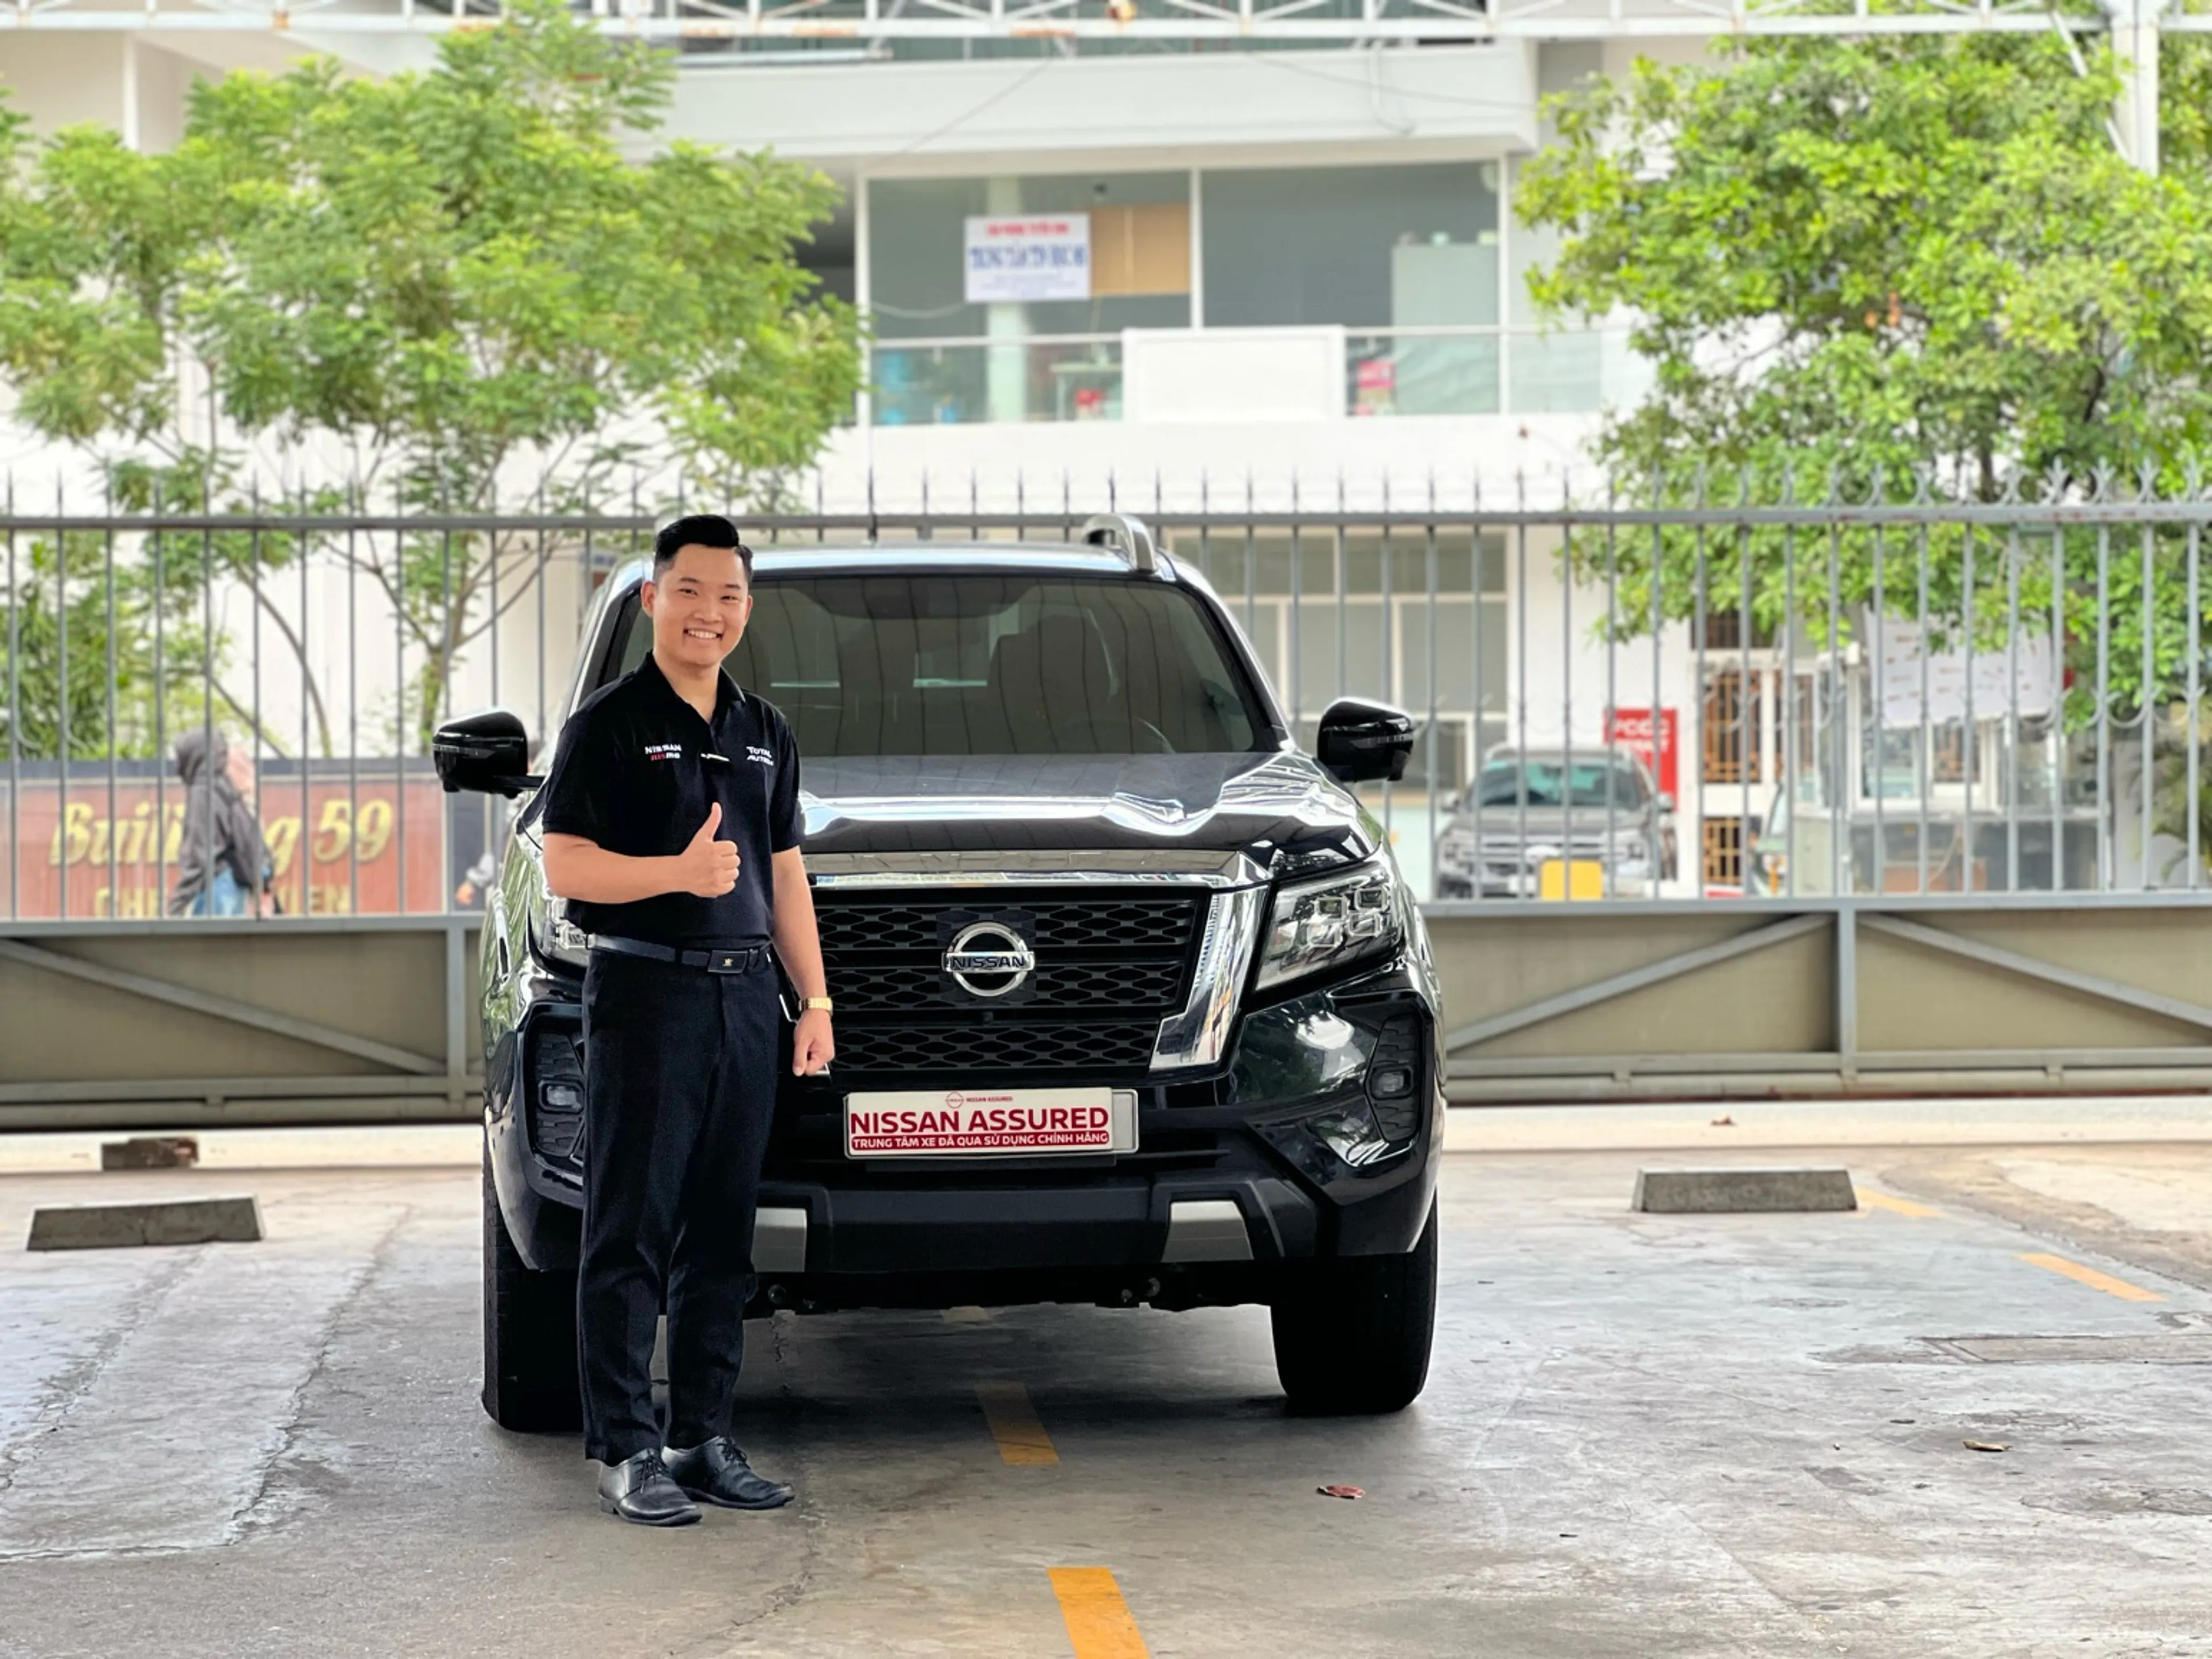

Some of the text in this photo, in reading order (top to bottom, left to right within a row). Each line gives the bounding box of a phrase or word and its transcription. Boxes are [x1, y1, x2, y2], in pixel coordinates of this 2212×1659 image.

[645, 744, 681, 754] NISSAN
[48, 798, 392, 877] Builg 59
[952, 956, 1025, 969] NISSAN
[851, 1107, 1108, 1134] NISSAN ASSURED
[853, 1138, 892, 1148] TRUNG
[895, 1135, 919, 1147] TÂM
[922, 1137, 935, 1146] XE
[938, 1135, 955, 1146] ĐÃ
[957, 1137, 982, 1146] QUA
[1002, 1134, 1035, 1146] DỤNG
[1037, 1131, 1073, 1144] CHÍNH
